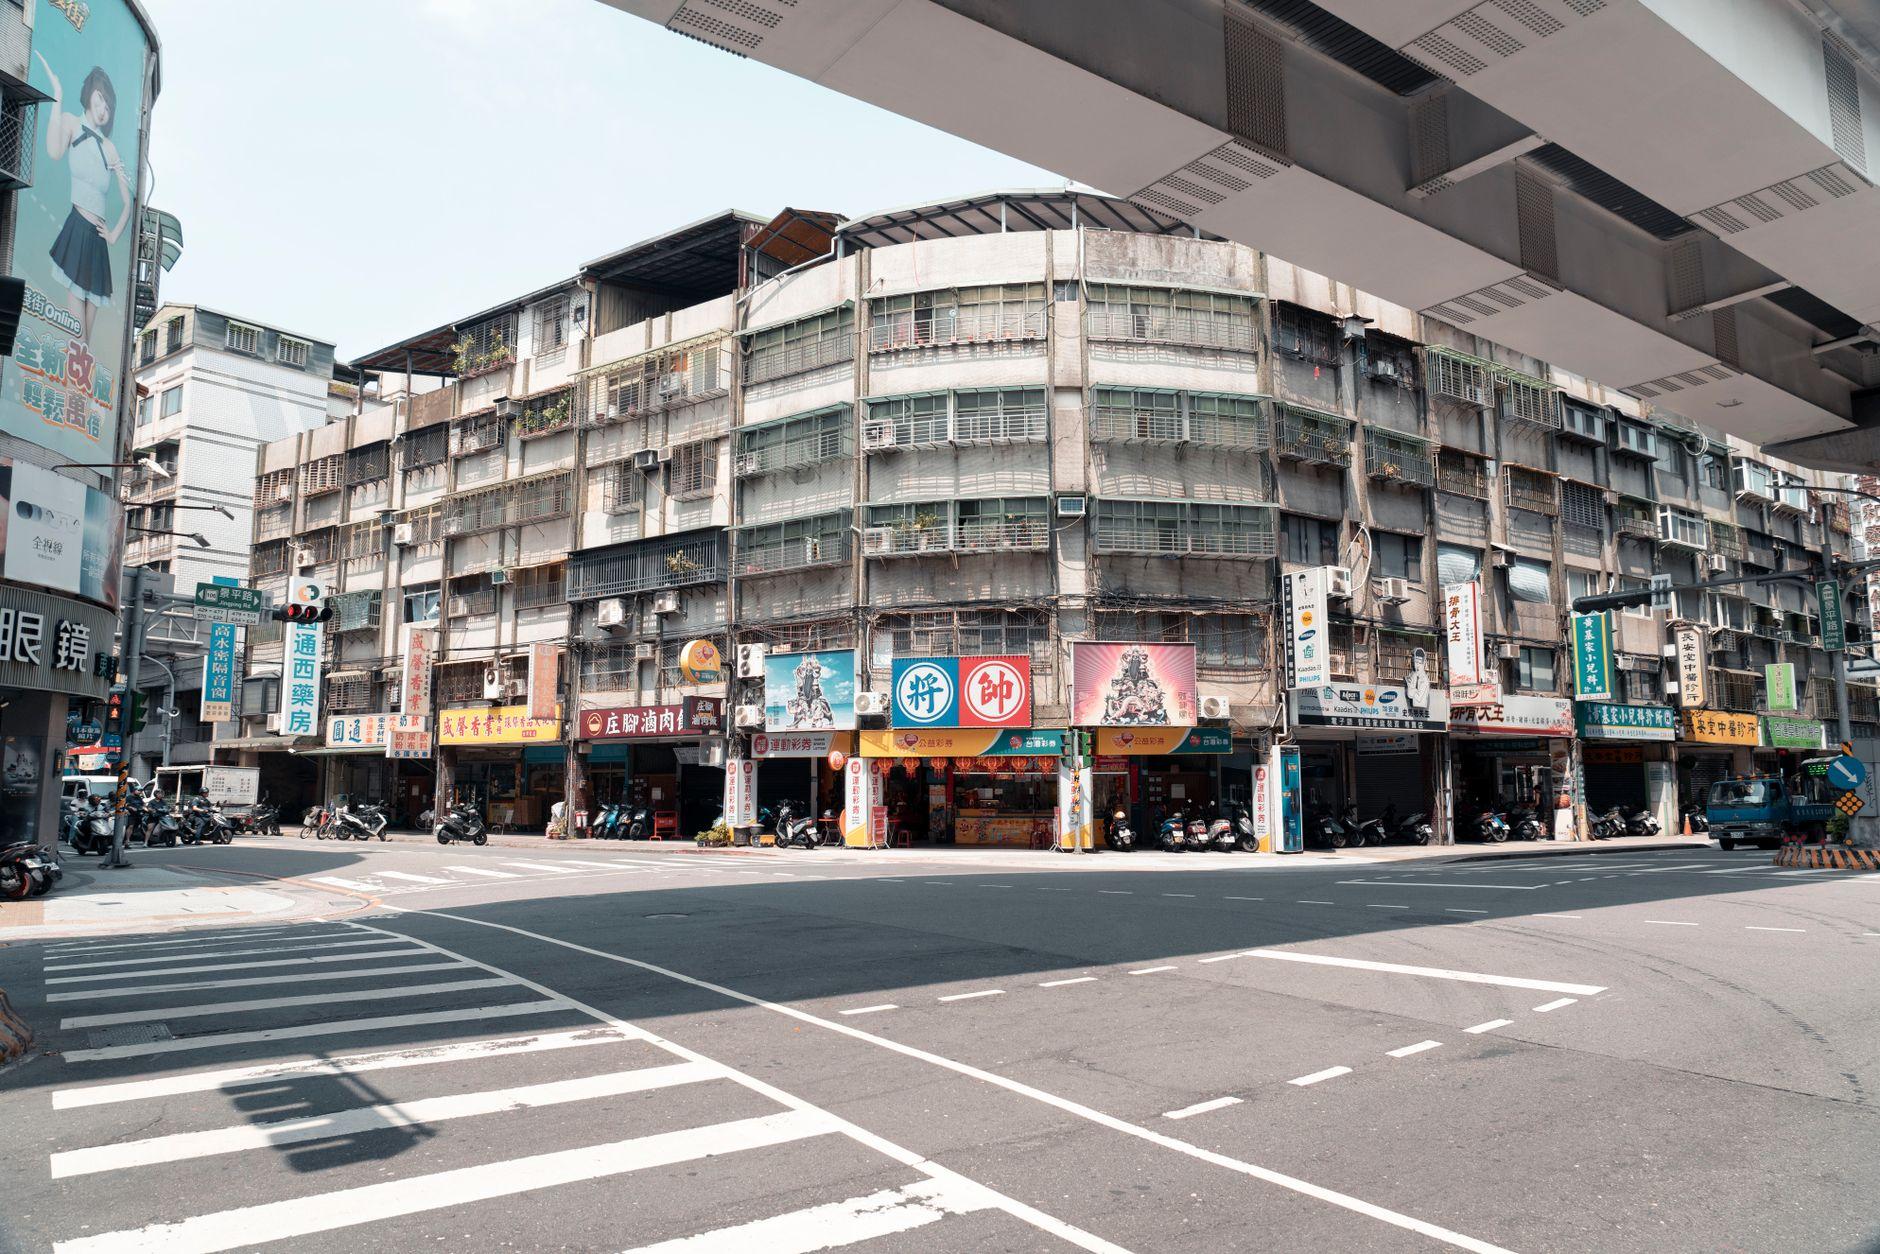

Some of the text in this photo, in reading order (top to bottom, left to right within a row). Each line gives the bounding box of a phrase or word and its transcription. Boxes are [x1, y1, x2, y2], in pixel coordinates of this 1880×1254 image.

[45, 304, 81, 333] Online
[16, 326, 113, 404] 全新改版
[24, 379, 100, 438] 輕鬆萬倍
[219, 588, 253, 602] 景平路
[1449, 595, 1461, 642] 排骨大王
[1824, 600, 1838, 630] 景平路
[0, 608, 90, 673] 眼鏡
[1299, 675, 1320, 683] PHILIPS
[1681, 632, 1700, 701] 長安堂中醫診所
[906, 672, 943, 713] 將
[978, 671, 1013, 714] 帥
[1360, 707, 1379, 715] PHILIPS
[770, 737, 812, 751] 運動彩券
[918, 738, 953, 748] 公益彩券
[1026, 740, 1056, 748] 台灣彩券
